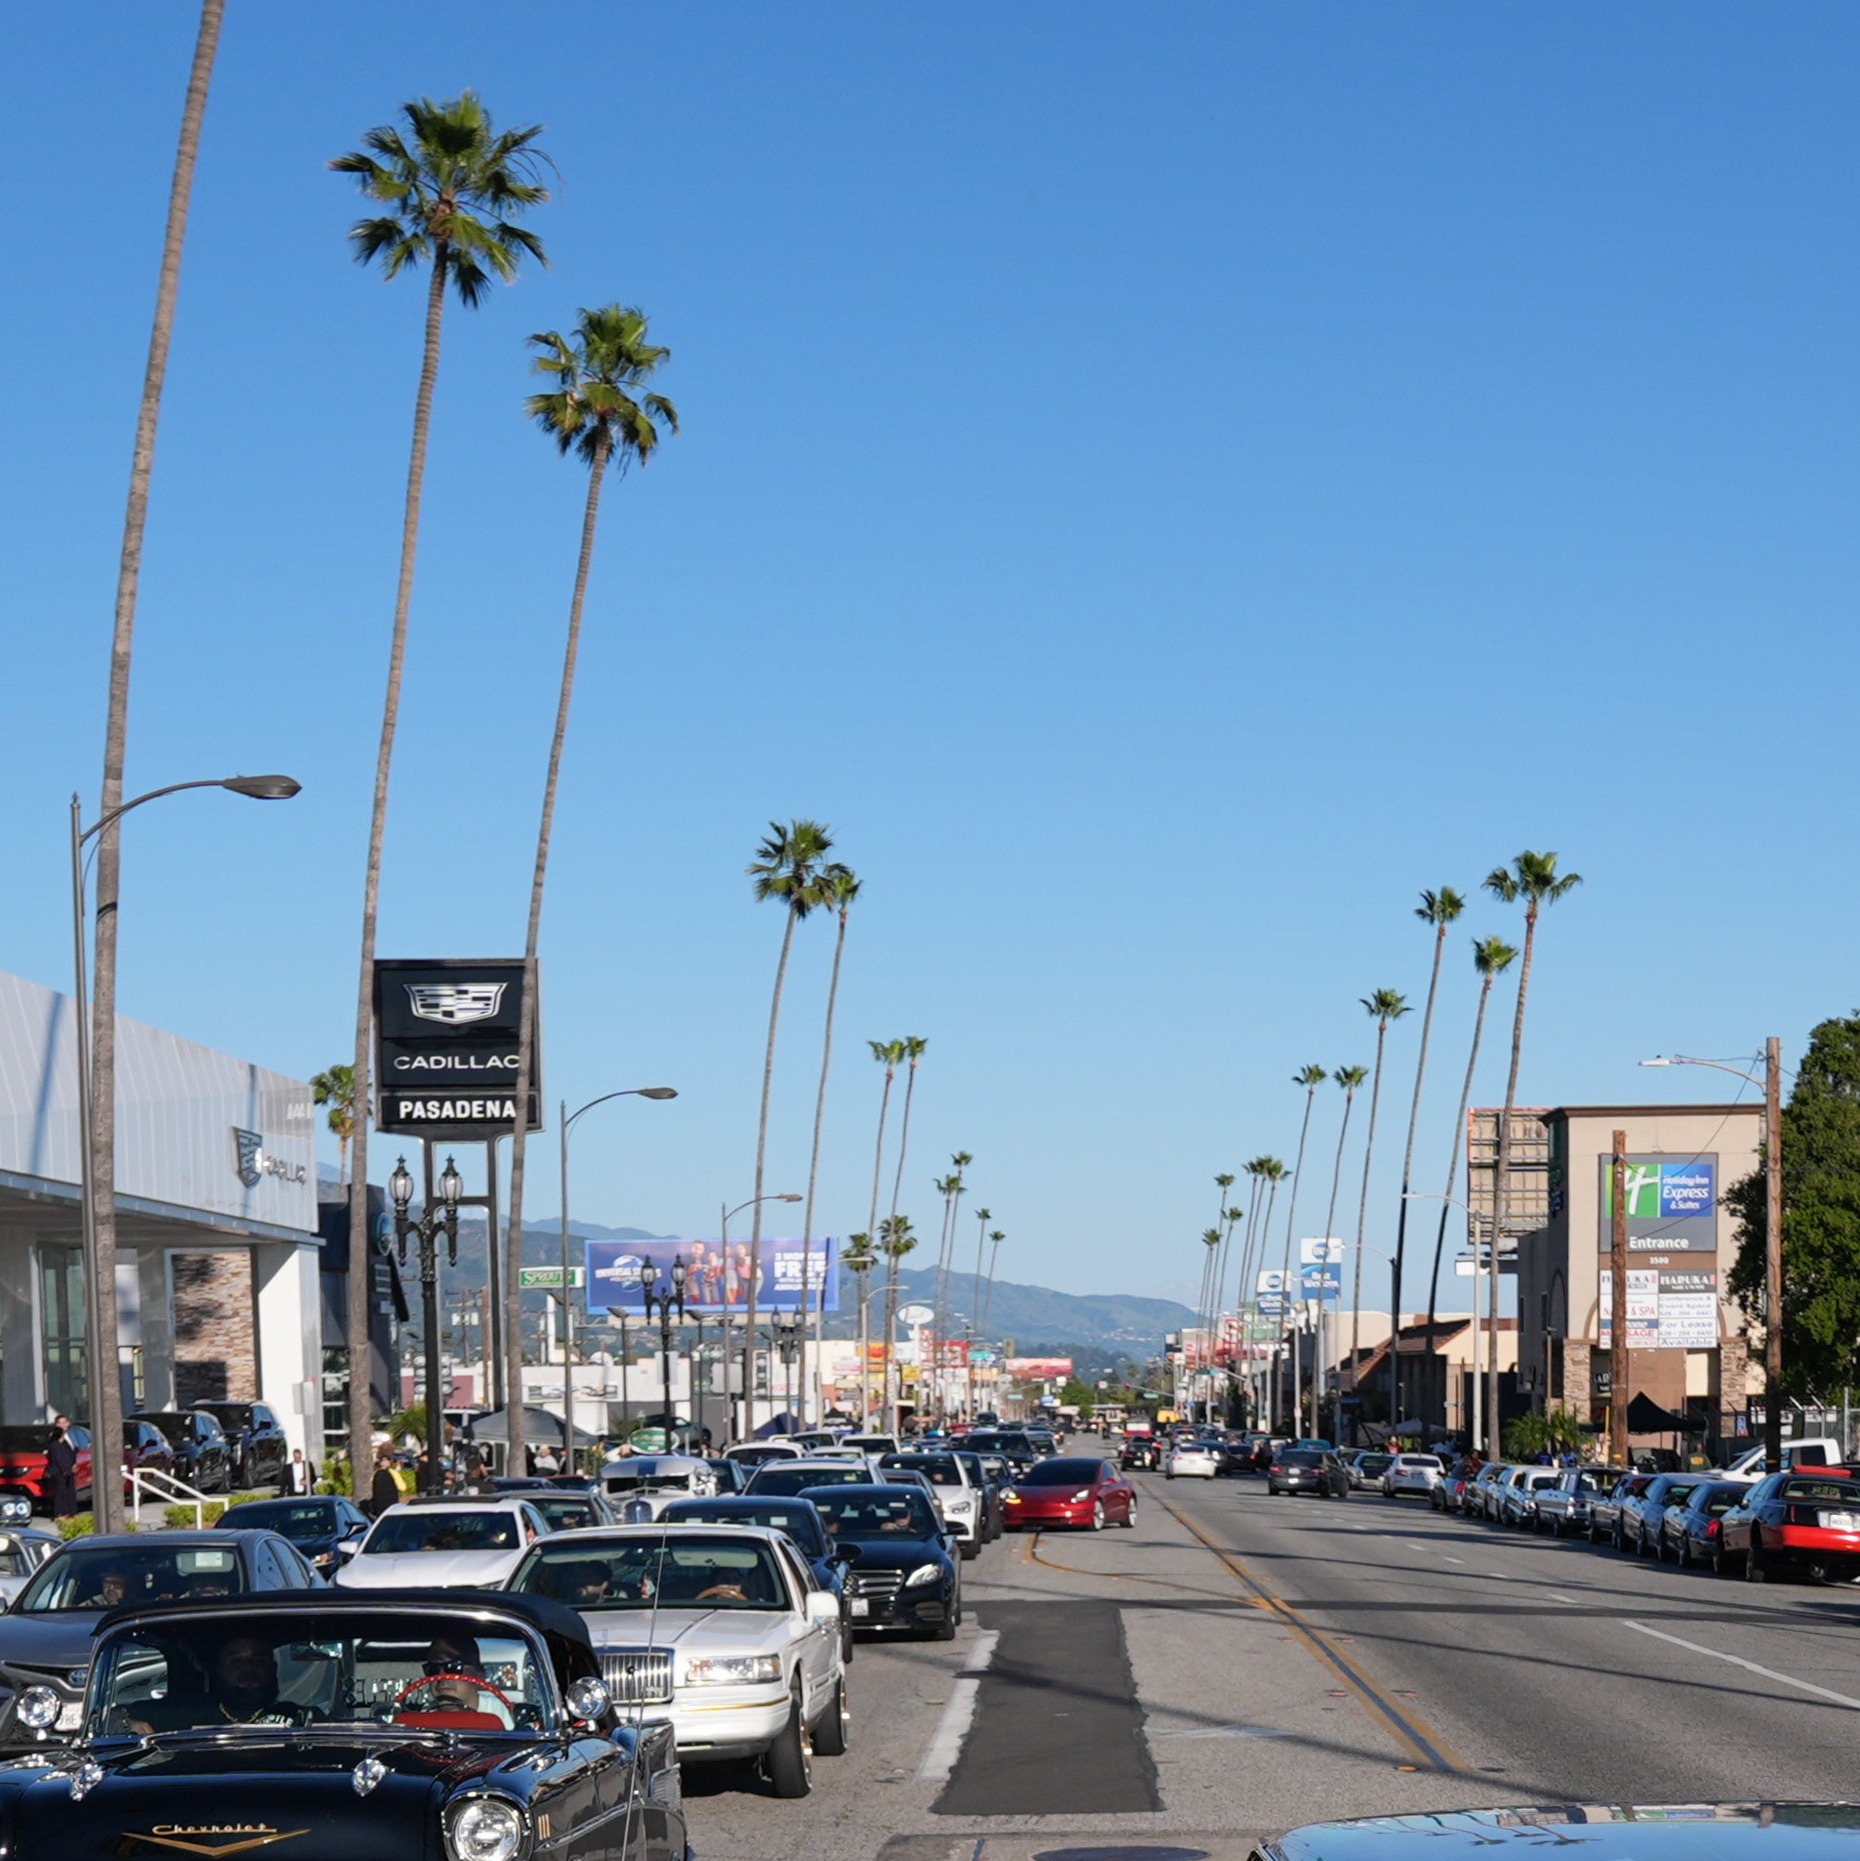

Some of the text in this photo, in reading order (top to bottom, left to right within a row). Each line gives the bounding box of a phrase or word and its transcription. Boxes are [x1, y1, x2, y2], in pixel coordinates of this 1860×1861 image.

[394, 1055, 520, 1070] CADILLAC
[400, 1101, 516, 1119] PASADENA
[1663, 1186, 1709, 1200] Express
[1629, 1237, 1689, 1250] Entrance
[1639, 1305, 1655, 1316] SPA
[1681, 1320, 1713, 1329] Lease
[1661, 1338, 1713, 1346] Available
[152, 1822, 277, 1835] Chevrolet
